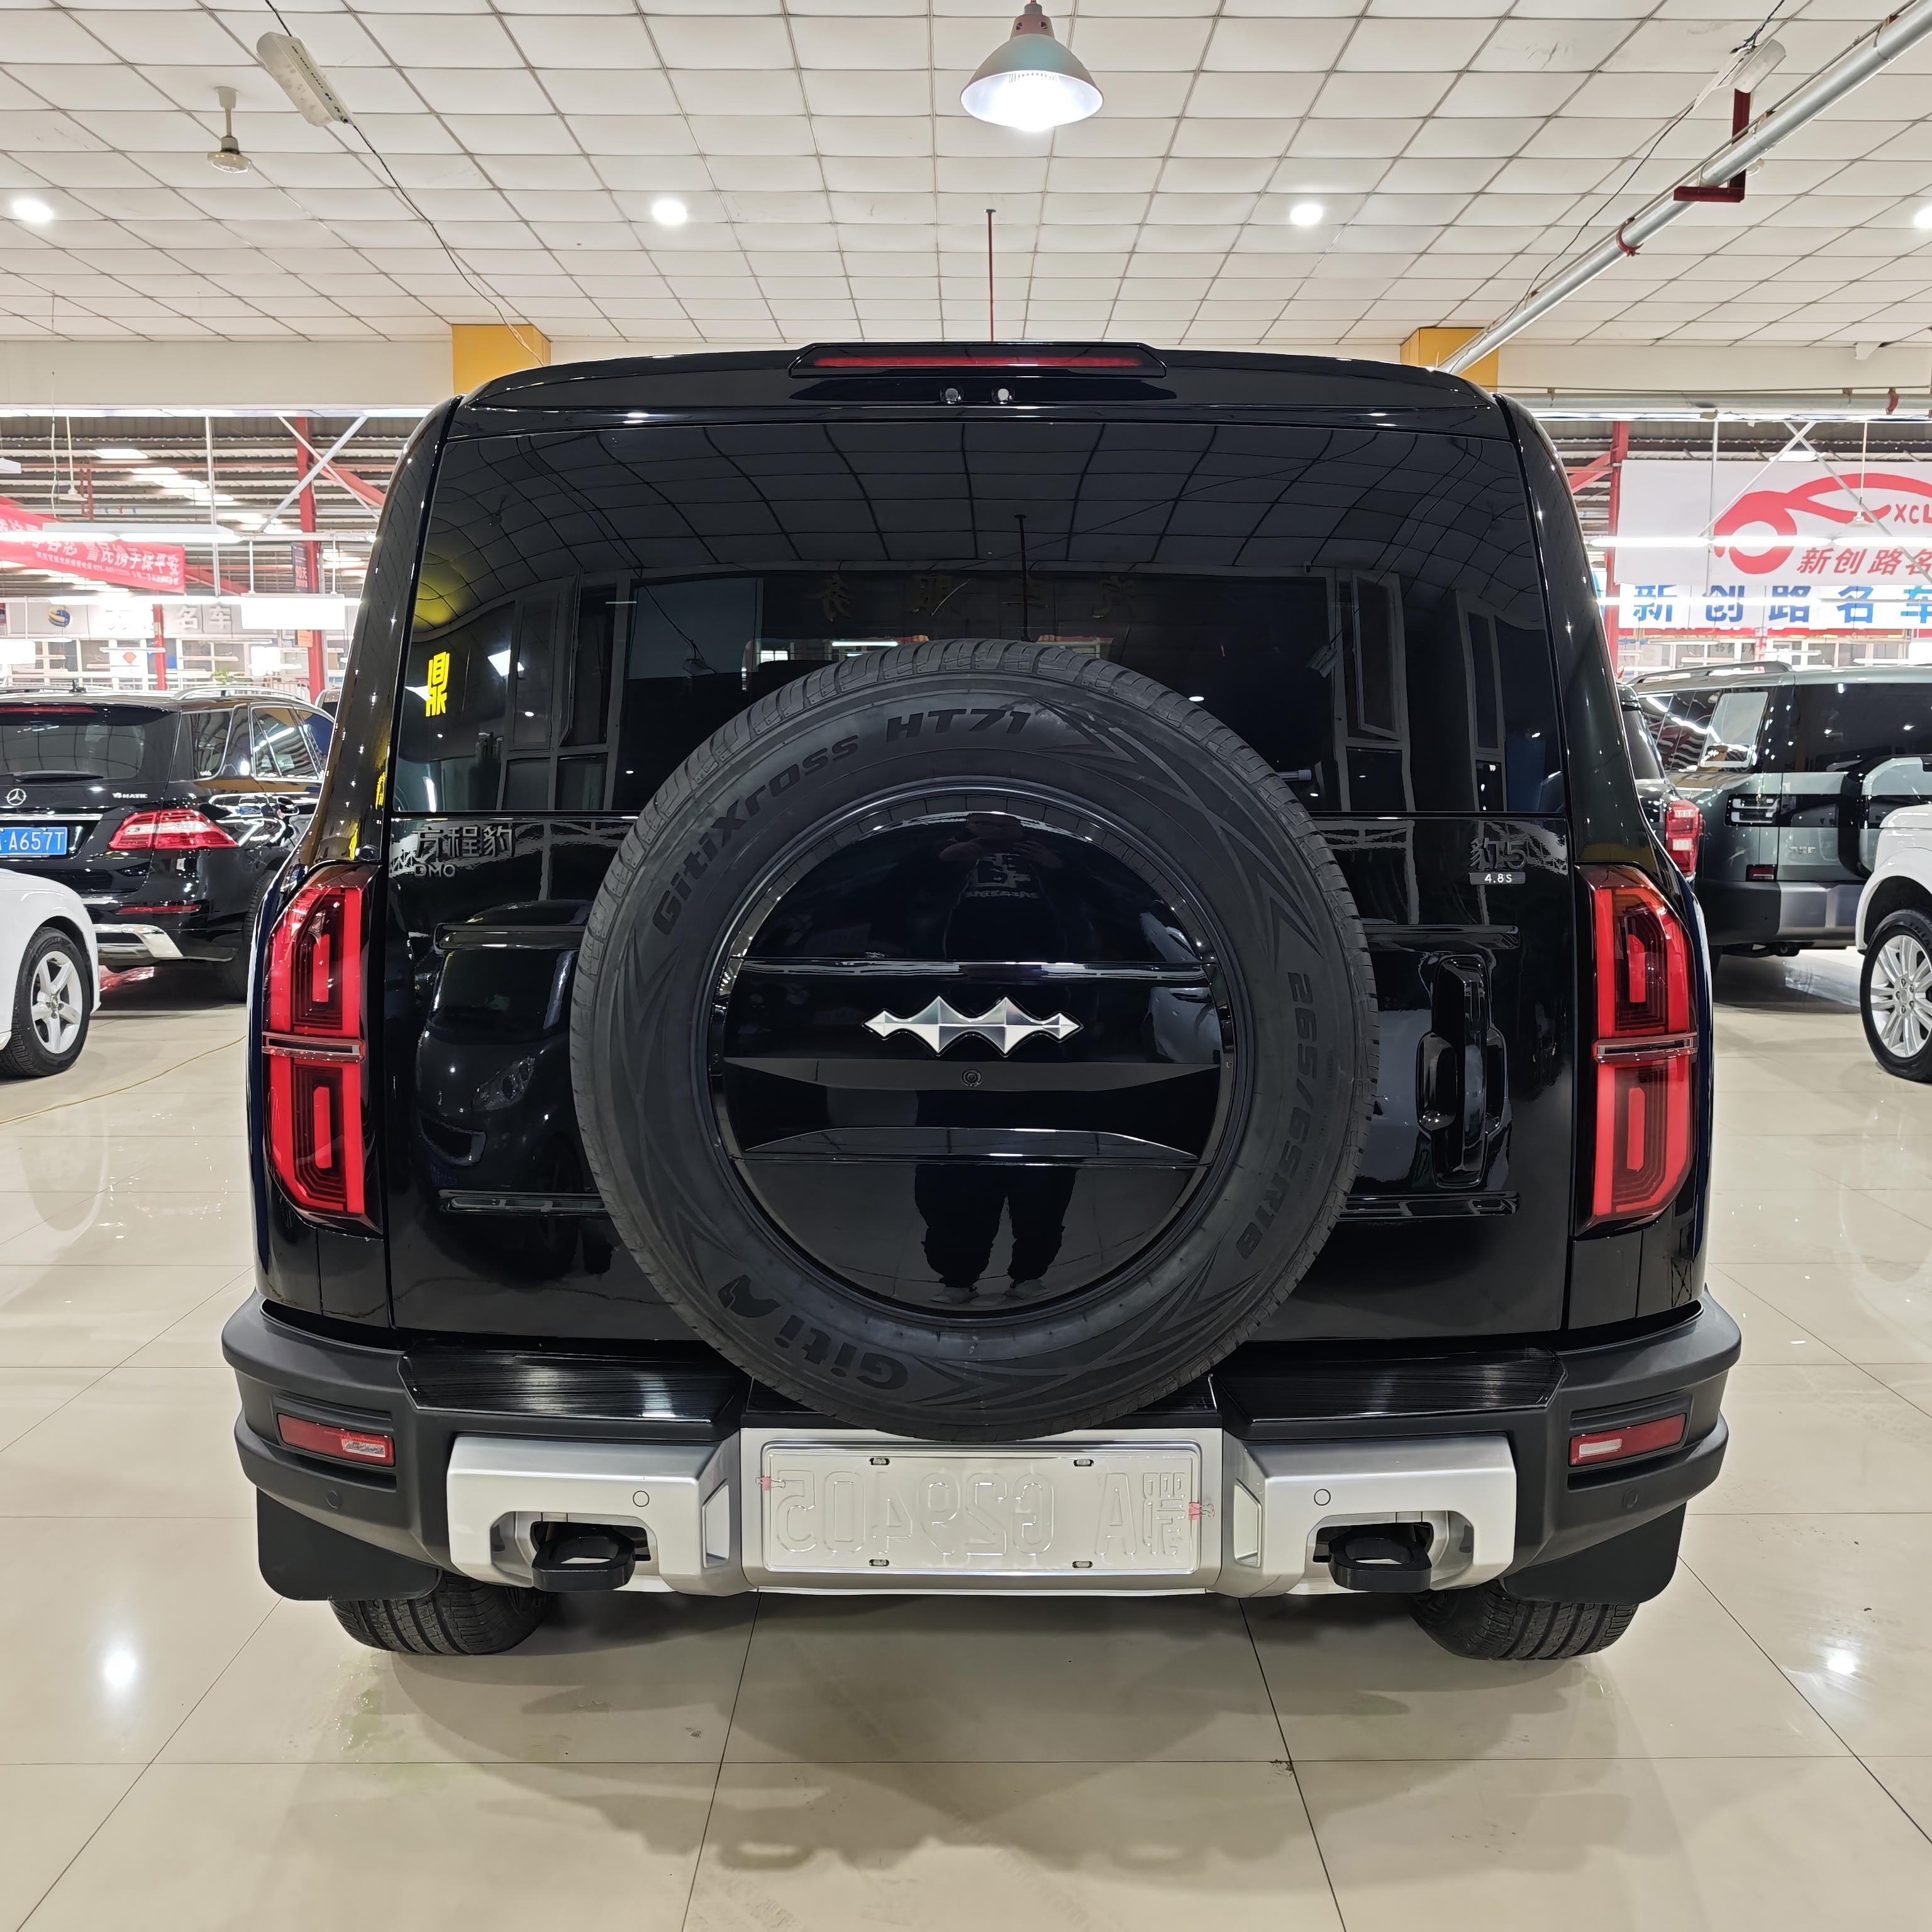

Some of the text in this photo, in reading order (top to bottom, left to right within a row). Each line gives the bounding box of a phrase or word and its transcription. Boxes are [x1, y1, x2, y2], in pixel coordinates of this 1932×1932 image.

[653, 708, 1031, 935] GitiXross HT71
[0, 831, 64, 850] ·A657T
[413, 826, 515, 858] 方程豹
[414, 863, 456, 877] DMO
[1484, 873, 1513, 884] 4.8S
[1235, 972, 1318, 1260] 265/65R18
[774, 1314, 909, 1390] Giti
